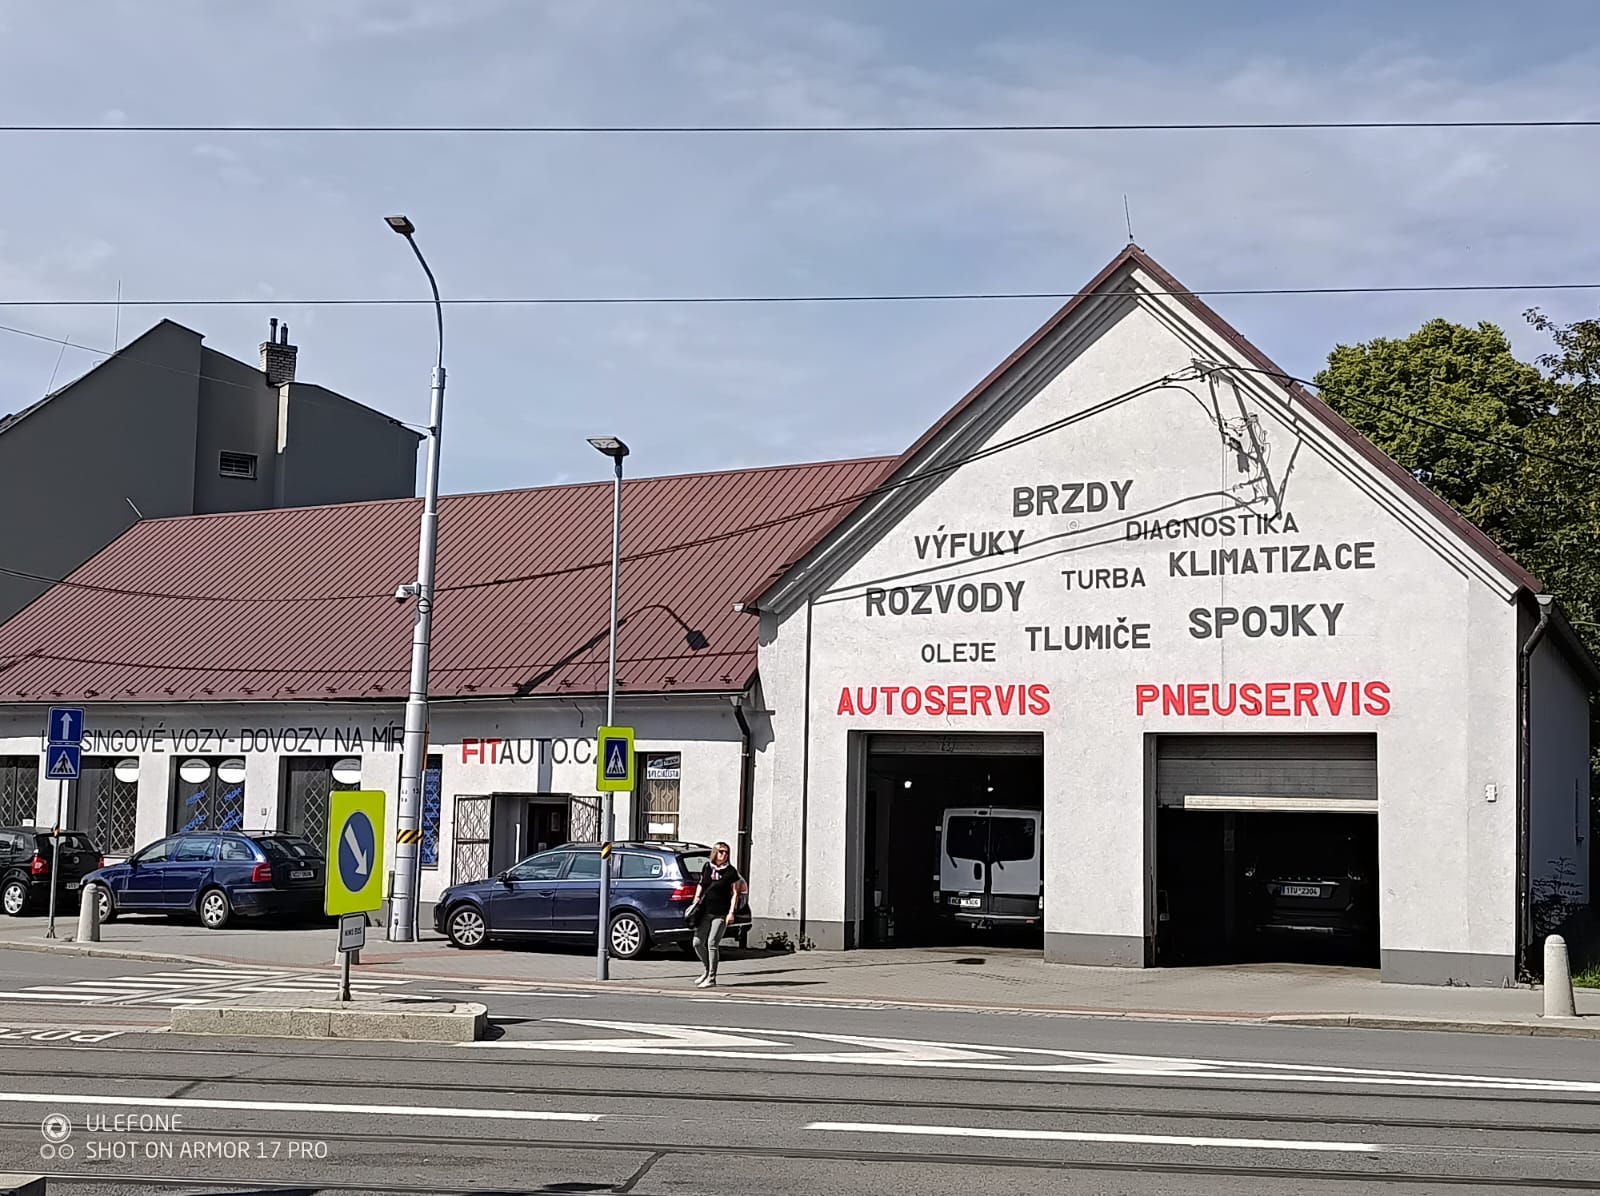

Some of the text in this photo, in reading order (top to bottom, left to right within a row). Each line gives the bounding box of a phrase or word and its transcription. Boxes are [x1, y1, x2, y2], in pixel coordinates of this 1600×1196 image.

[1013, 479, 1133, 518] BRZDY
[914, 524, 1025, 561] VÝFUKY
[1125, 513, 1300, 543] DIAGNOSTIKA
[1169, 541, 1376, 578] KLIMATIZACE
[1061, 567, 1146, 591] TURBA
[865, 580, 1026, 618] ROZVODY
[1024, 616, 1151, 652] TLUMIČE
[1188, 603, 1345, 639] SPOJKY
[921, 642, 996, 663] OLEJE
[836, 683, 1052, 717] AUTOSERVIS
[1135, 681, 1391, 718] PNEUSERVIS
[41, 722, 167, 753] LSINGOVÉ
[240, 727, 328, 753] DOVOZY
[334, 726, 364, 753] NA
[461, 738, 598, 765] FITAUTO.C
